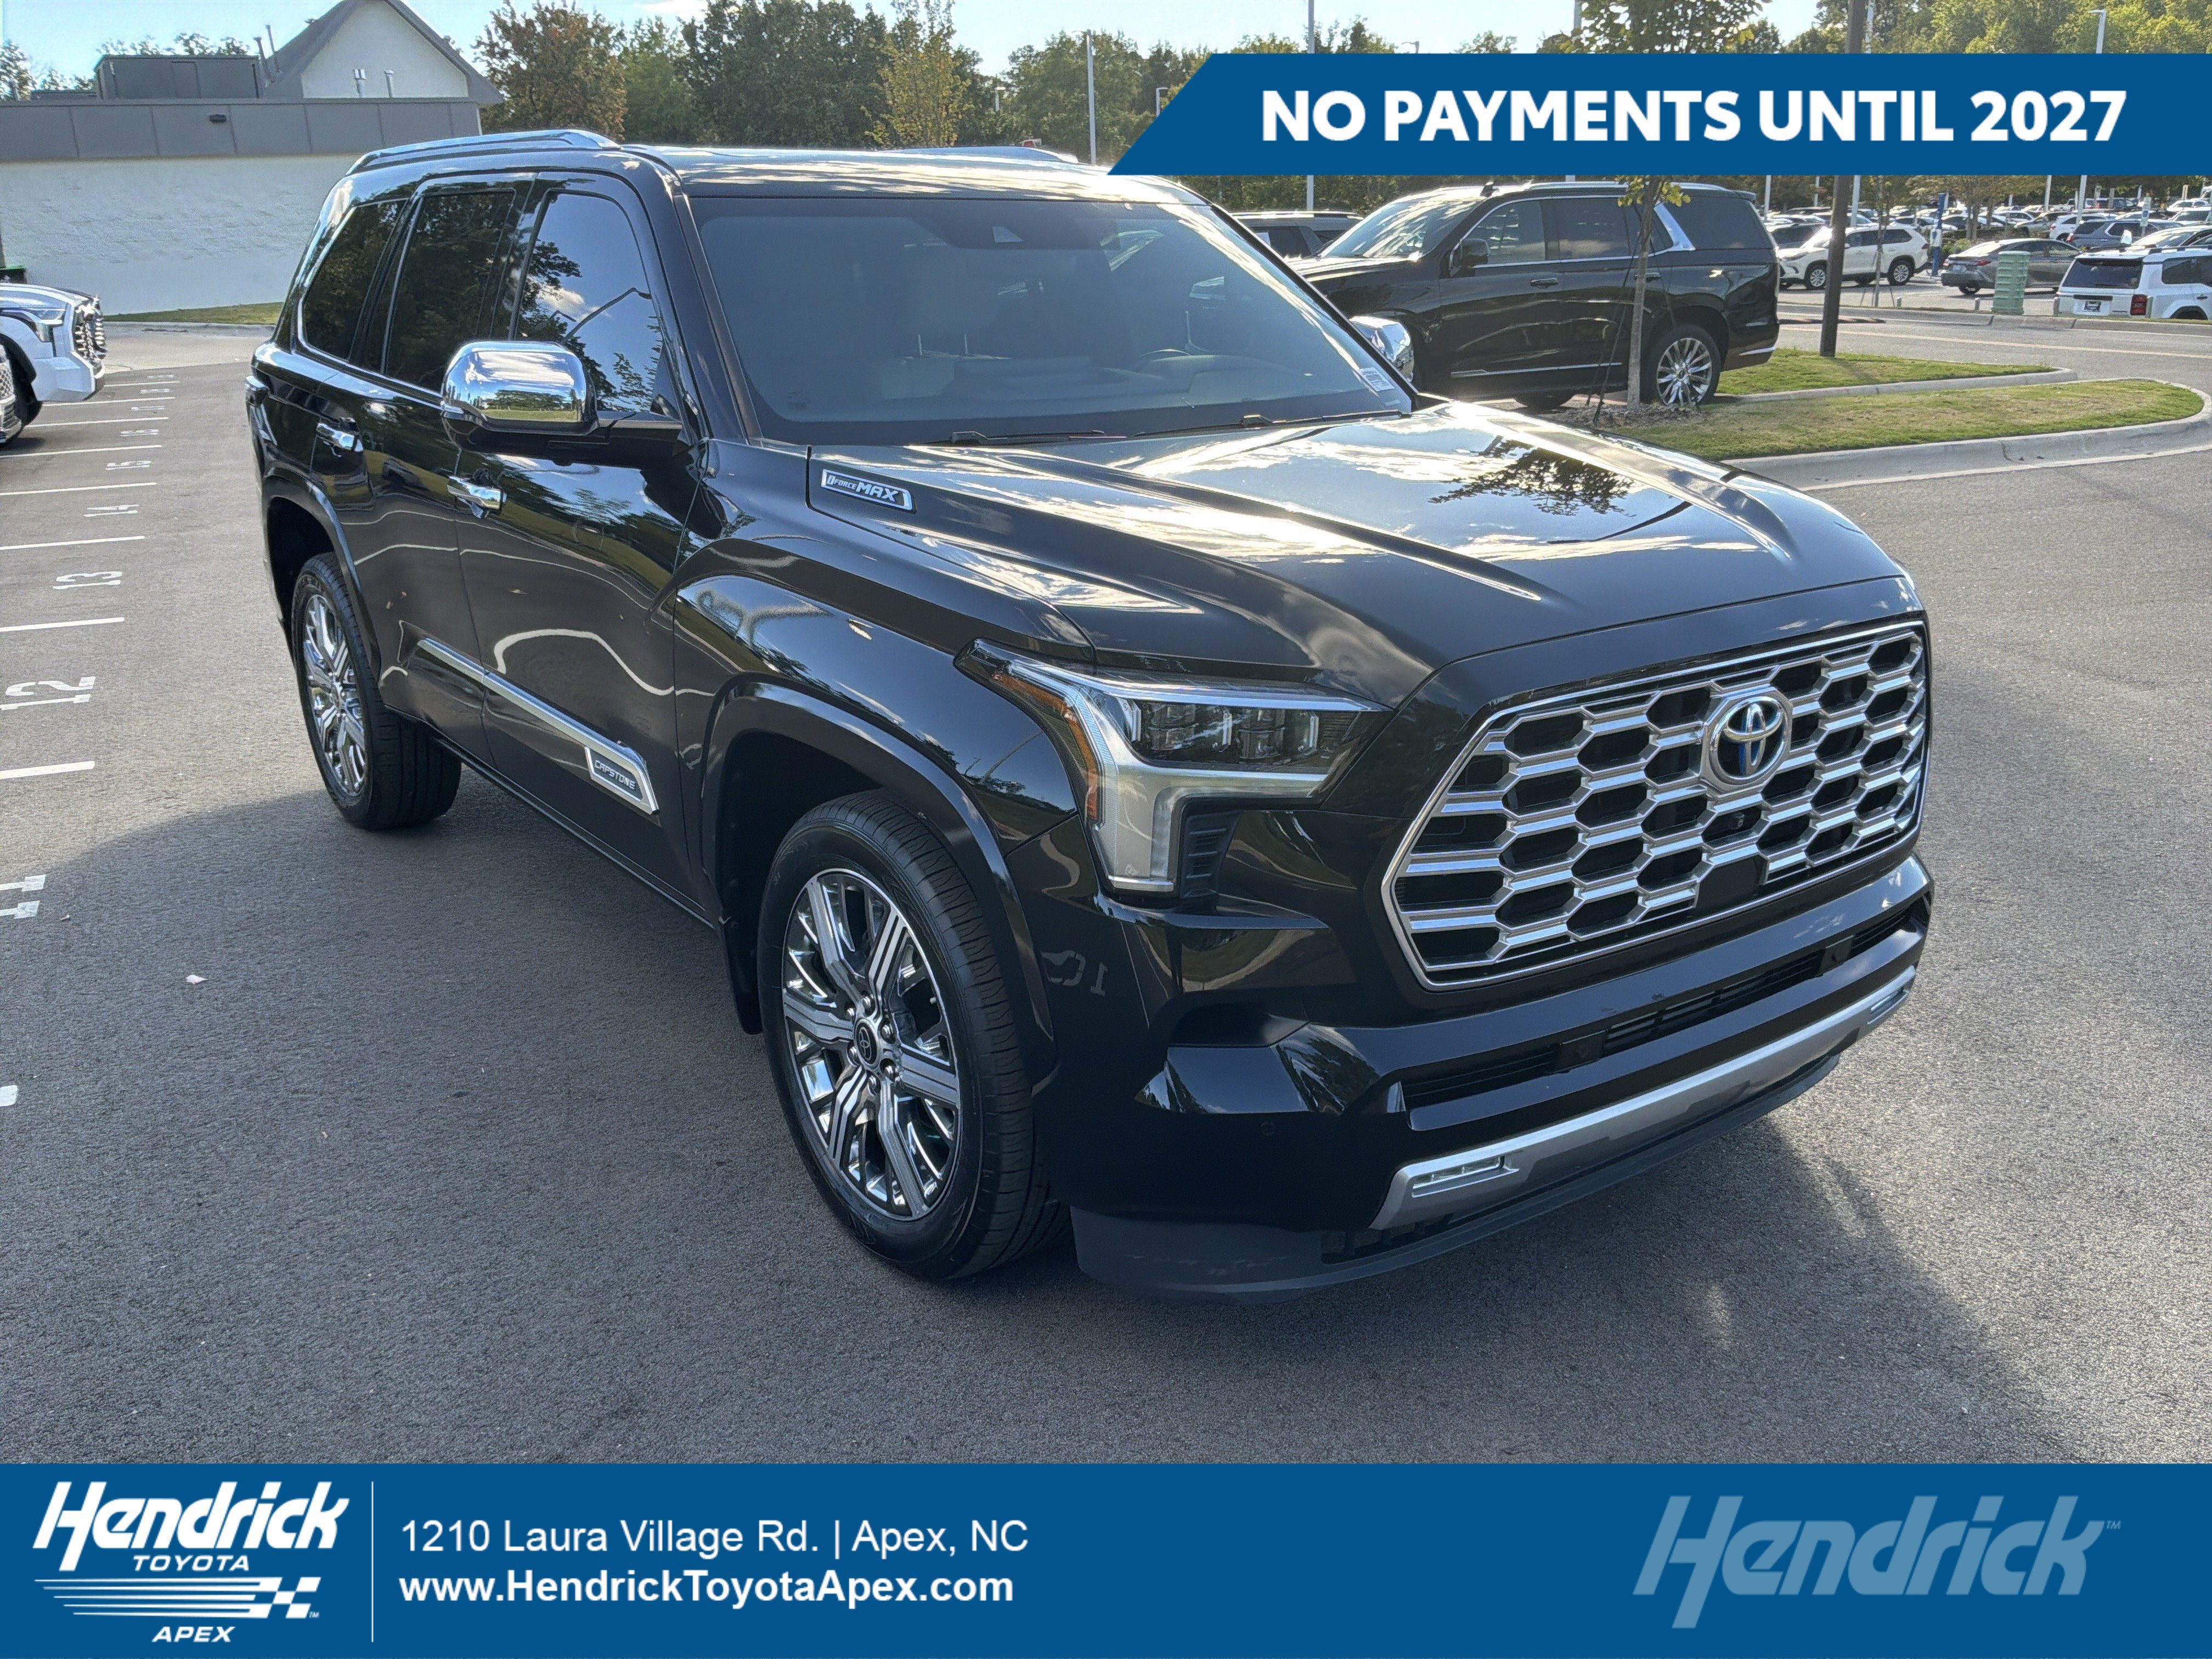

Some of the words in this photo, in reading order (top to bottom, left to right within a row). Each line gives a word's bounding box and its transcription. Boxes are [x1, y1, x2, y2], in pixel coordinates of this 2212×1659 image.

[855, 481, 898, 502] MAX
[53, 571, 123, 590] 13
[0, 676, 96, 710] 12
[594, 759, 636, 790] CAPSTONE
